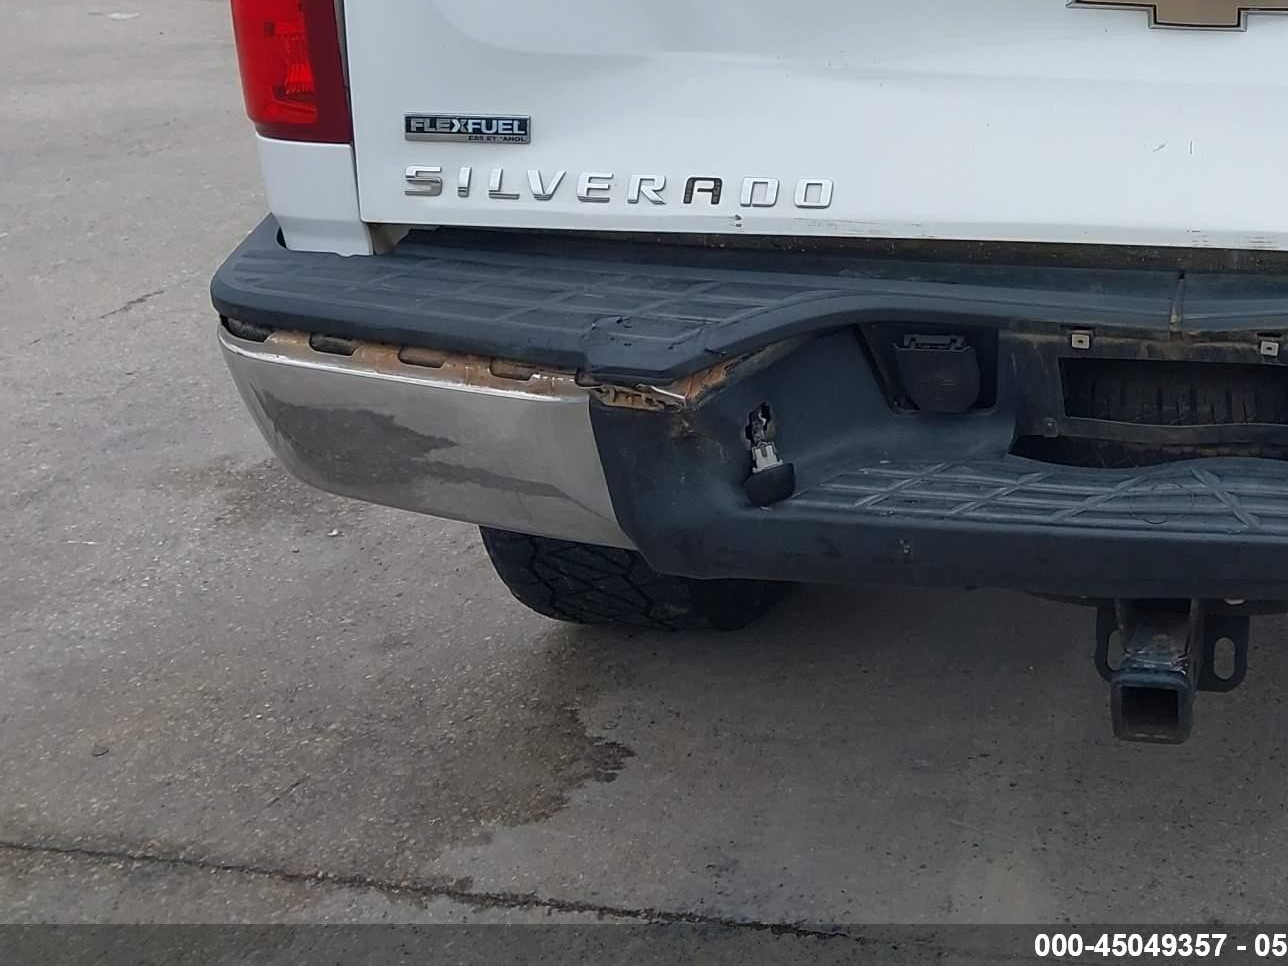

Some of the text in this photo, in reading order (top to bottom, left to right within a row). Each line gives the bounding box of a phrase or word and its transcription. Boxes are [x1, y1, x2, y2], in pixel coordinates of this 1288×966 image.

[410, 118, 526, 134] FLEXFUEL
[486, 135, 527, 143] ETANOL
[403, 164, 834, 209] SILVERADO
